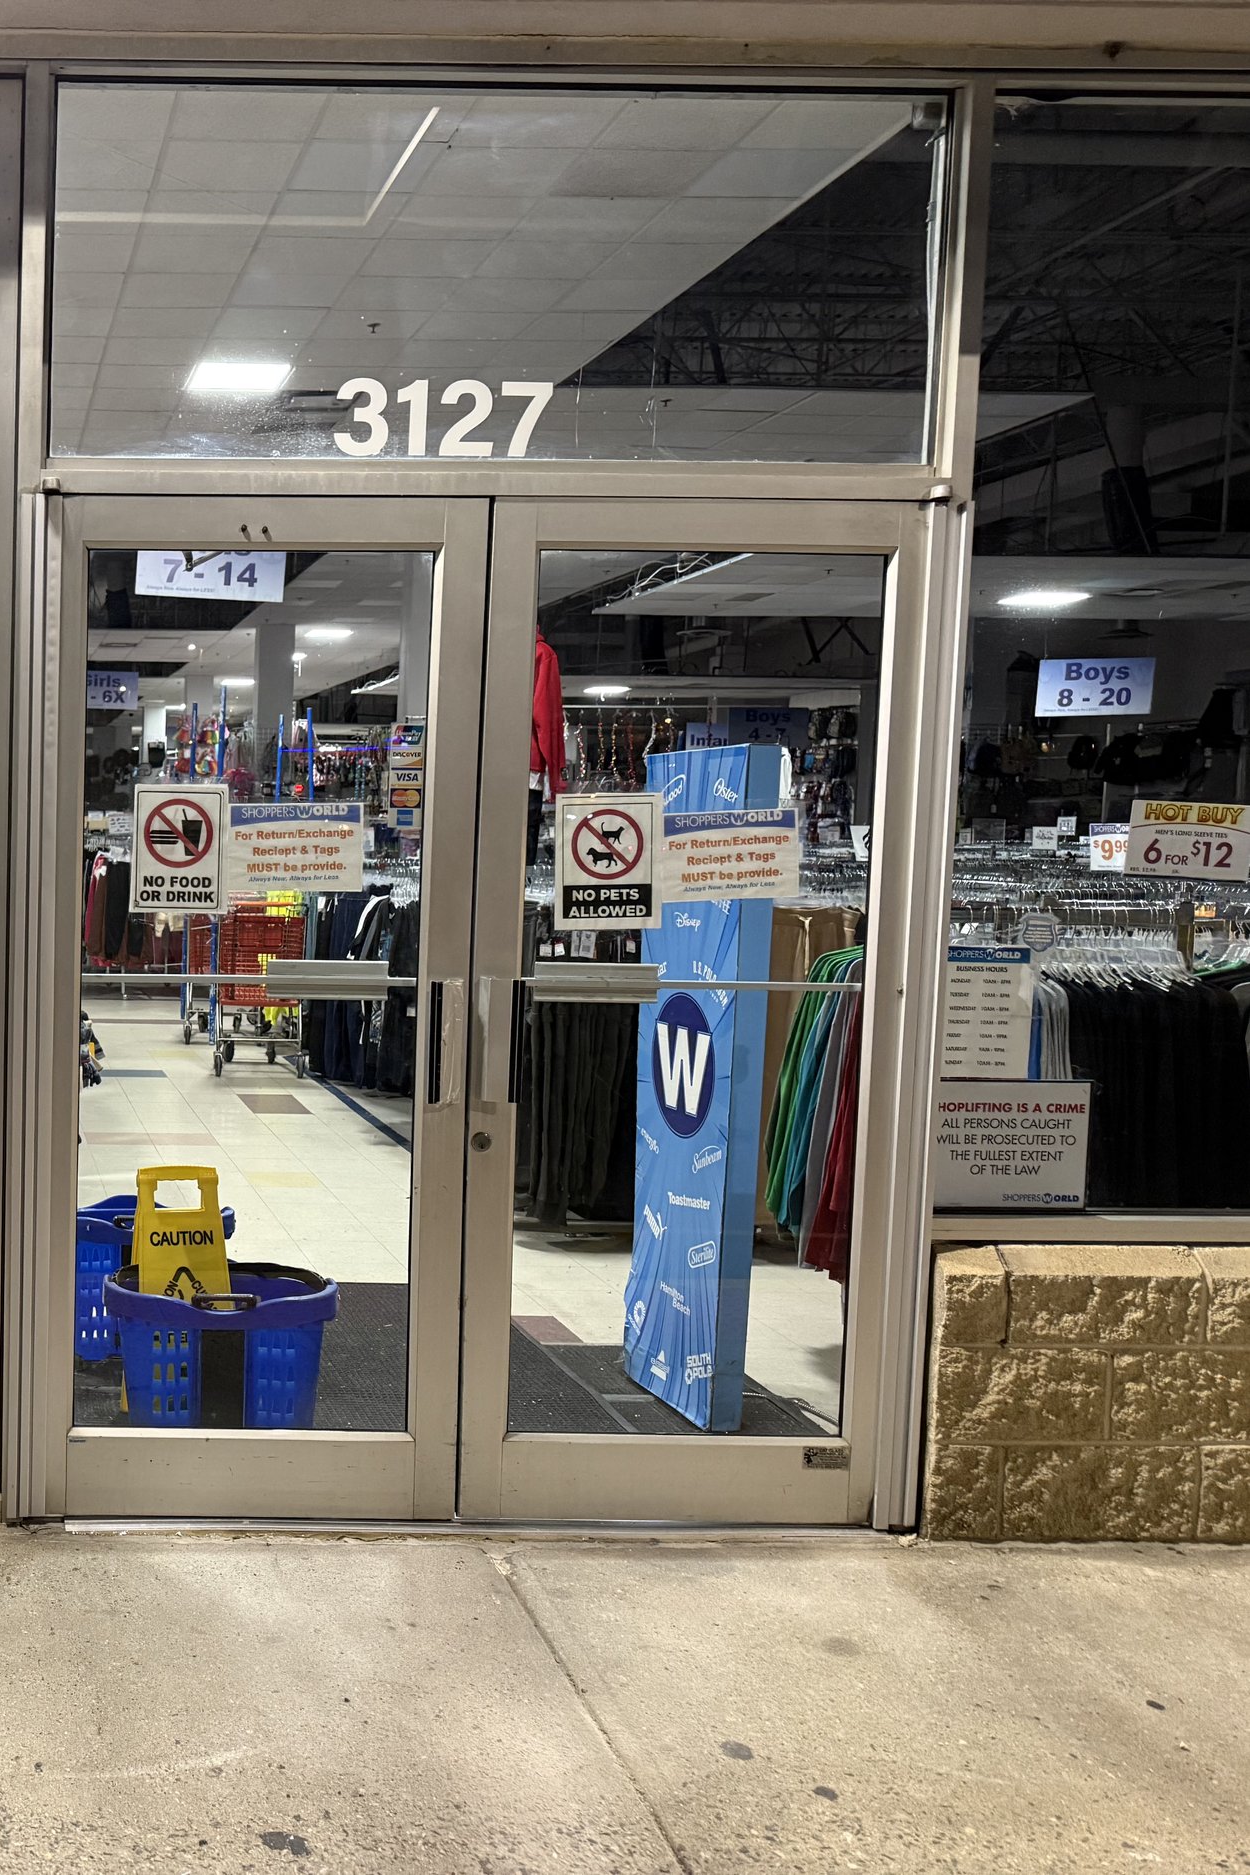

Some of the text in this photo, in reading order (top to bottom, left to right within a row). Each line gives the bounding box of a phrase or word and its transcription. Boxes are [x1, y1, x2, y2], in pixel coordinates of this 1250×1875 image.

[333, 377, 554, 457] 3127
[163, 558, 183, 583] 7
[217, 561, 258, 588] 14
[1065, 662, 1130, 685] Boys
[1057, 689, 1073, 707] 8
[1098, 687, 1132, 706] 20
[745, 709, 791, 725] Boys
[395, 773, 419, 782] VISA
[713, 777, 738, 803] Oster
[1145, 803, 1245, 825] HOT BUY
[234, 828, 354, 841] For Return/Exchange
[300, 846, 309, 855] &
[312, 845, 340, 857] Tags
[668, 834, 789, 852] For Return/Exchange
[735, 853, 744, 863] &
[748, 851, 776, 865] Tags
[1143, 838, 1234, 868] 6 FOR $12
[246, 860, 347, 874] MUST be provide.
[143, 876, 212, 889] NO FOOD
[681, 867, 784, 884] MUST be provide.
[140, 890, 214, 903] OR DRINK
[572, 888, 640, 901] NO PETS
[569, 905, 647, 918] ALLOWED
[656, 1020, 712, 1117] W
[938, 1102, 1086, 1114] HOPLIFTING IS A CRIME
[941, 1118, 1072, 1129] ALL PERSONS CAUGHT
[937, 1134, 1077, 1146] WILL BE PROSECUTED TO
[692, 1145, 722, 1174] Sunbeam
[950, 1150, 1064, 1161] THE FULLEST EXTENT
[970, 1164, 1041, 1175] OF THE LAW
[667, 1191, 711, 1210] Toastmaster
[150, 1230, 214, 1246] CAUTION
[691, 1246, 715, 1264] Sterilite
[660, 1281, 685, 1302] Hamilton
[672, 1299, 691, 1316] Beach
[686, 1353, 712, 1368] SOUTH
